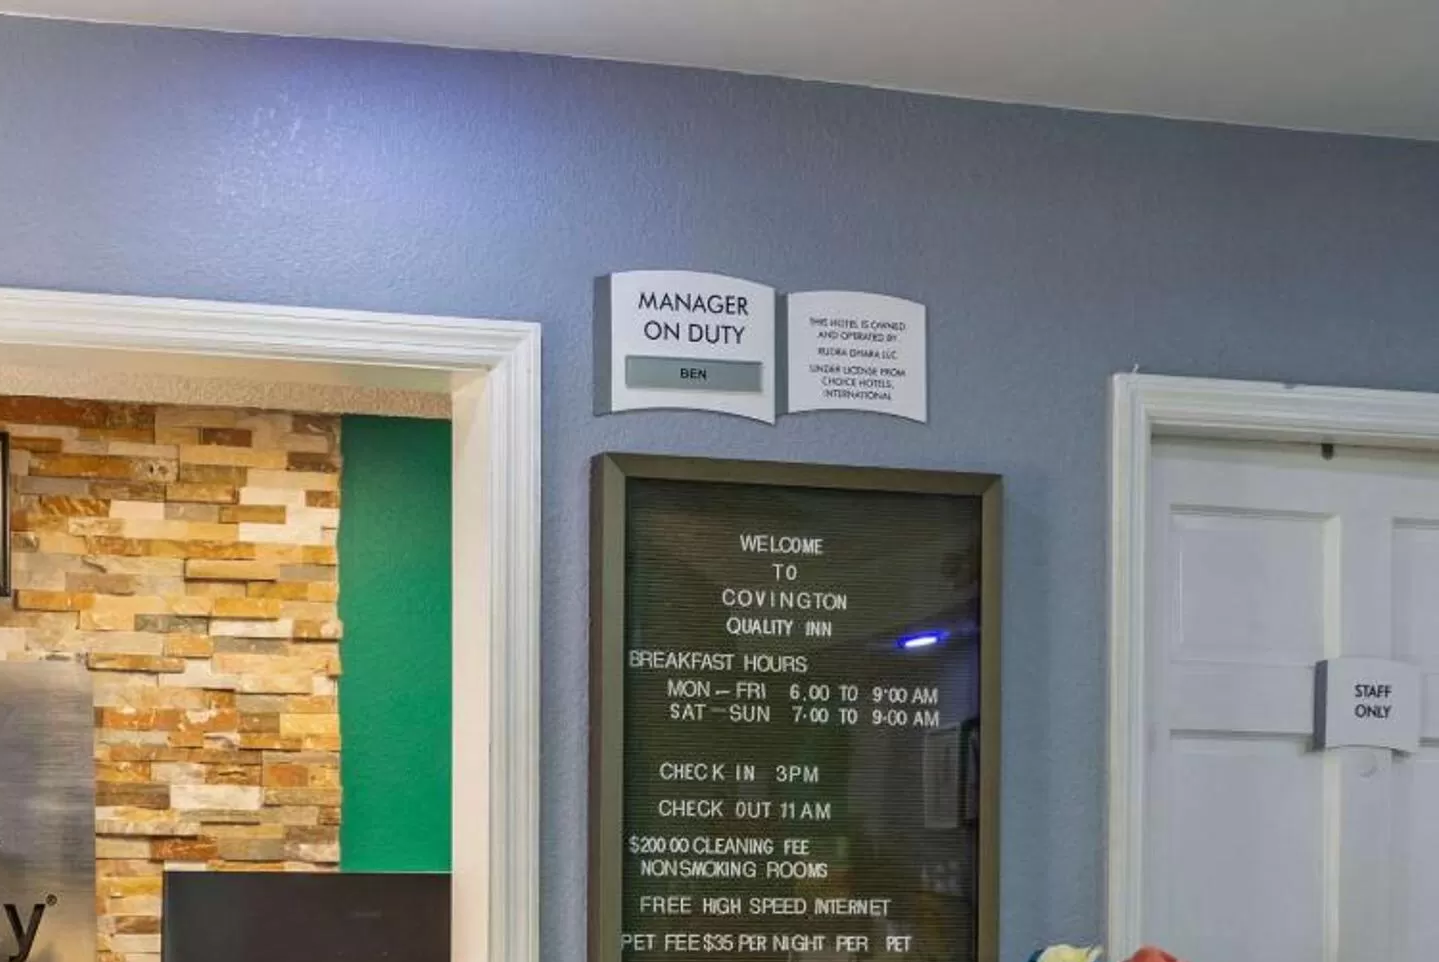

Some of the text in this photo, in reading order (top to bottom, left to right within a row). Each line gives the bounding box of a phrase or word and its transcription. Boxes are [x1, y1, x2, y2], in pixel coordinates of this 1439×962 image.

[638, 291, 749, 316] MANAGER
[644, 320, 745, 344] ON DUTY
[680, 367, 707, 381] BEN
[740, 534, 824, 556] WELCOME
[772, 563, 797, 582] TO
[722, 588, 847, 611] COVINGTON
[726, 616, 832, 637] QUALITY INN
[629, 650, 808, 673] BREAKFAST HOURS
[667, 678, 710, 698] MON
[736, 681, 766, 699] FRI
[838, 684, 858, 702] TO
[912, 687, 939, 705] AM
[1354, 684, 1392, 698] STAFF
[670, 702, 706, 722] SAT
[729, 703, 771, 723] SUN
[838, 707, 858, 725] TO
[913, 710, 940, 728] AM
[1354, 703, 1392, 719] ONLY
[659, 761, 819, 783] CHECK IN 3PM
[658, 799, 724, 818] CHECK
[735, 801, 771, 819] OUT
[693, 837, 774, 855] CLEANING
[783, 838, 810, 855] FEE
[640, 859, 828, 879] NONSMOKING ROOMS
[639, 895, 891, 917] FREE HIGH SPEED INTERNET
[620, 933, 656, 951] PET
[738, 934, 768, 952] PER
[772, 934, 826, 952] NIGHT
[836, 935, 868, 952] PER
[885, 935, 912, 953] PET
